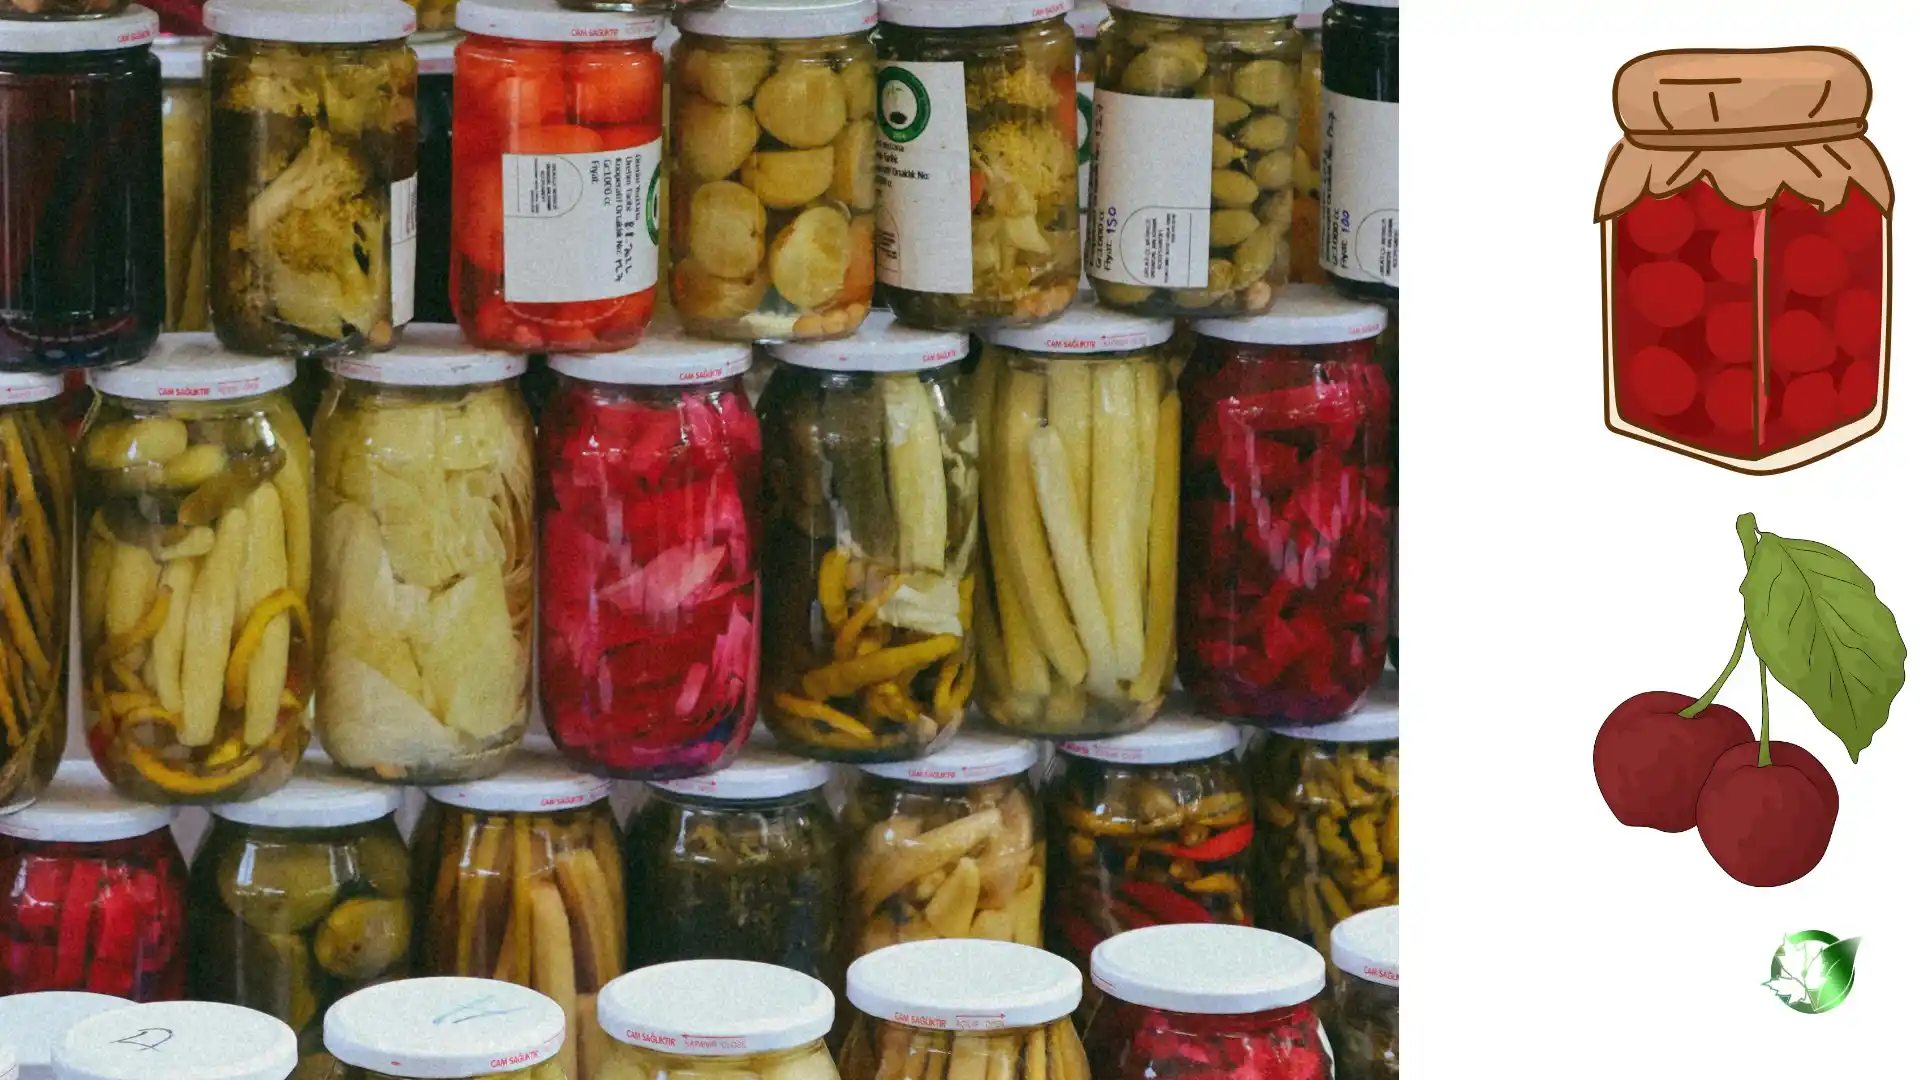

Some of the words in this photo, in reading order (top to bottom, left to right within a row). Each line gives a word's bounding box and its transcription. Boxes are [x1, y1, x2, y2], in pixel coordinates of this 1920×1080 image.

[1107, 206, 1117, 234] 150
[1341, 210, 1351, 233] 100
[626, 1029, 641, 1039] CAM
[642, 1031, 676, 1047] SAĞLIKTIR
[490, 1058, 508, 1068] CAM
